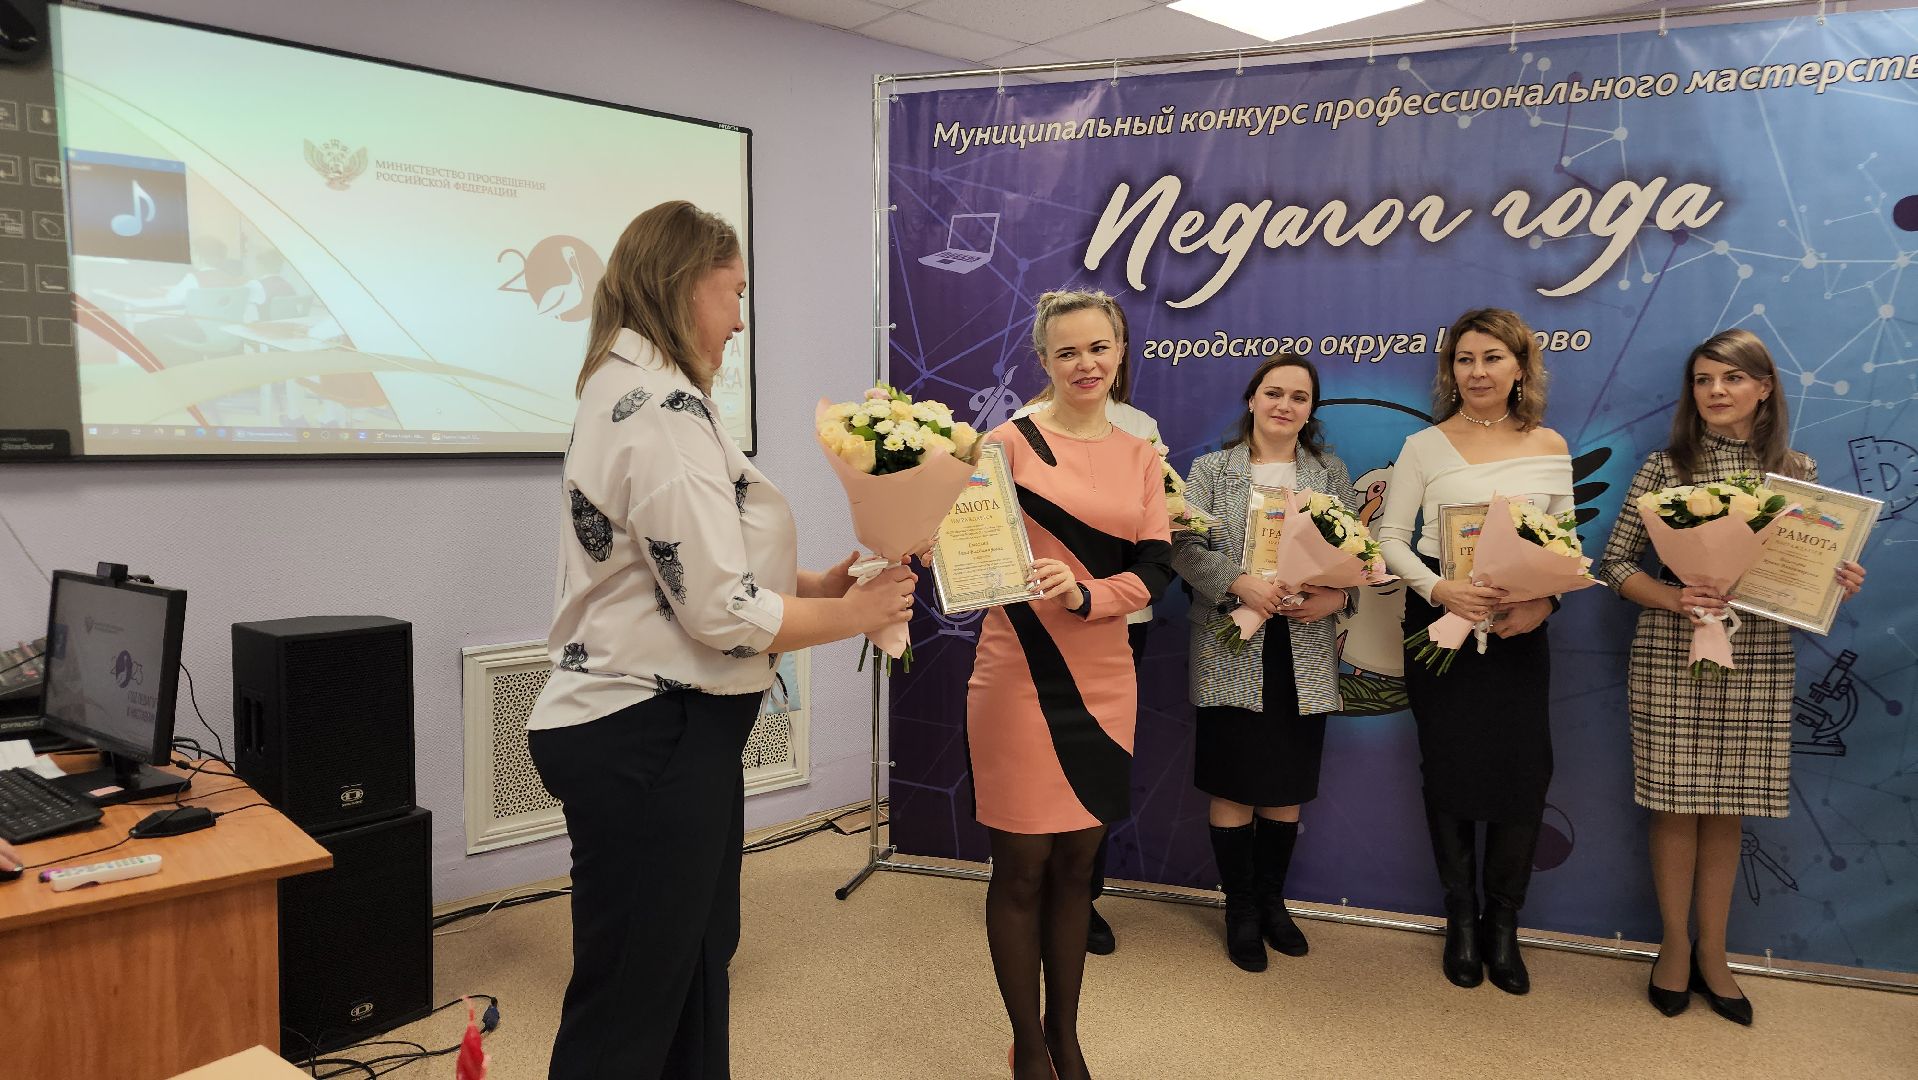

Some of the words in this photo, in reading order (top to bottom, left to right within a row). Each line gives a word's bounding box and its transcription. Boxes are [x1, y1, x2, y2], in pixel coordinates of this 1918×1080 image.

[933, 105, 1173, 154] Муниципальный
[1180, 103, 1309, 137] конкурс
[1313, 72, 1680, 130] профессионального
[375, 159, 465, 180] МИНИСТЕРСТВО
[467, 173, 547, 191] ПРОСВЕЩЕНИЯ
[376, 171, 451, 189] РОССИЙСКОЙ
[453, 182, 518, 198] ФЕДЕРАЦИИ
[1083, 174, 1473, 309] Педагог
[1491, 176, 1724, 297] года
[1142, 330, 1313, 366] городского
[1319, 332, 1428, 363] округа
[948, 499, 1000, 515] АМОТА
[1776, 526, 1837, 551] РАМОТА
